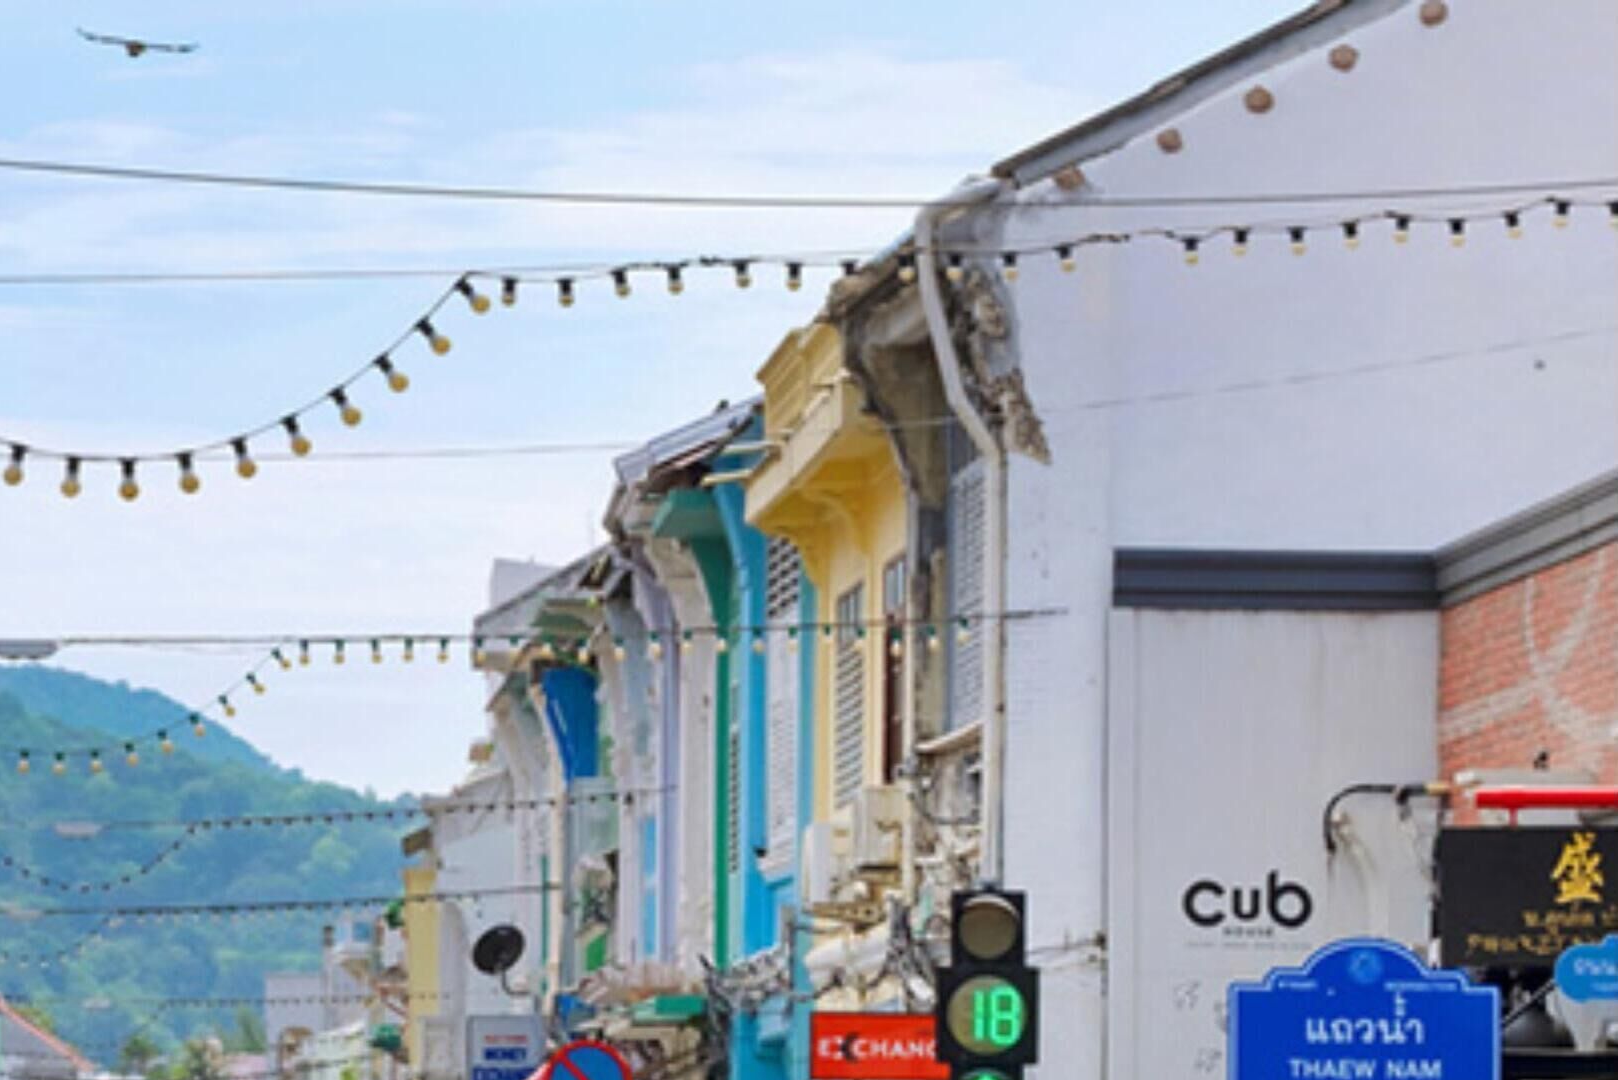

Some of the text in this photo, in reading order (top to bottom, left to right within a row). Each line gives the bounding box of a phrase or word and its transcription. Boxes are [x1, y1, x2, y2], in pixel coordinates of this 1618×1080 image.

[972, 985, 1024, 1047] 18
[1290, 1058, 1442, 1080] THAEW NAM
